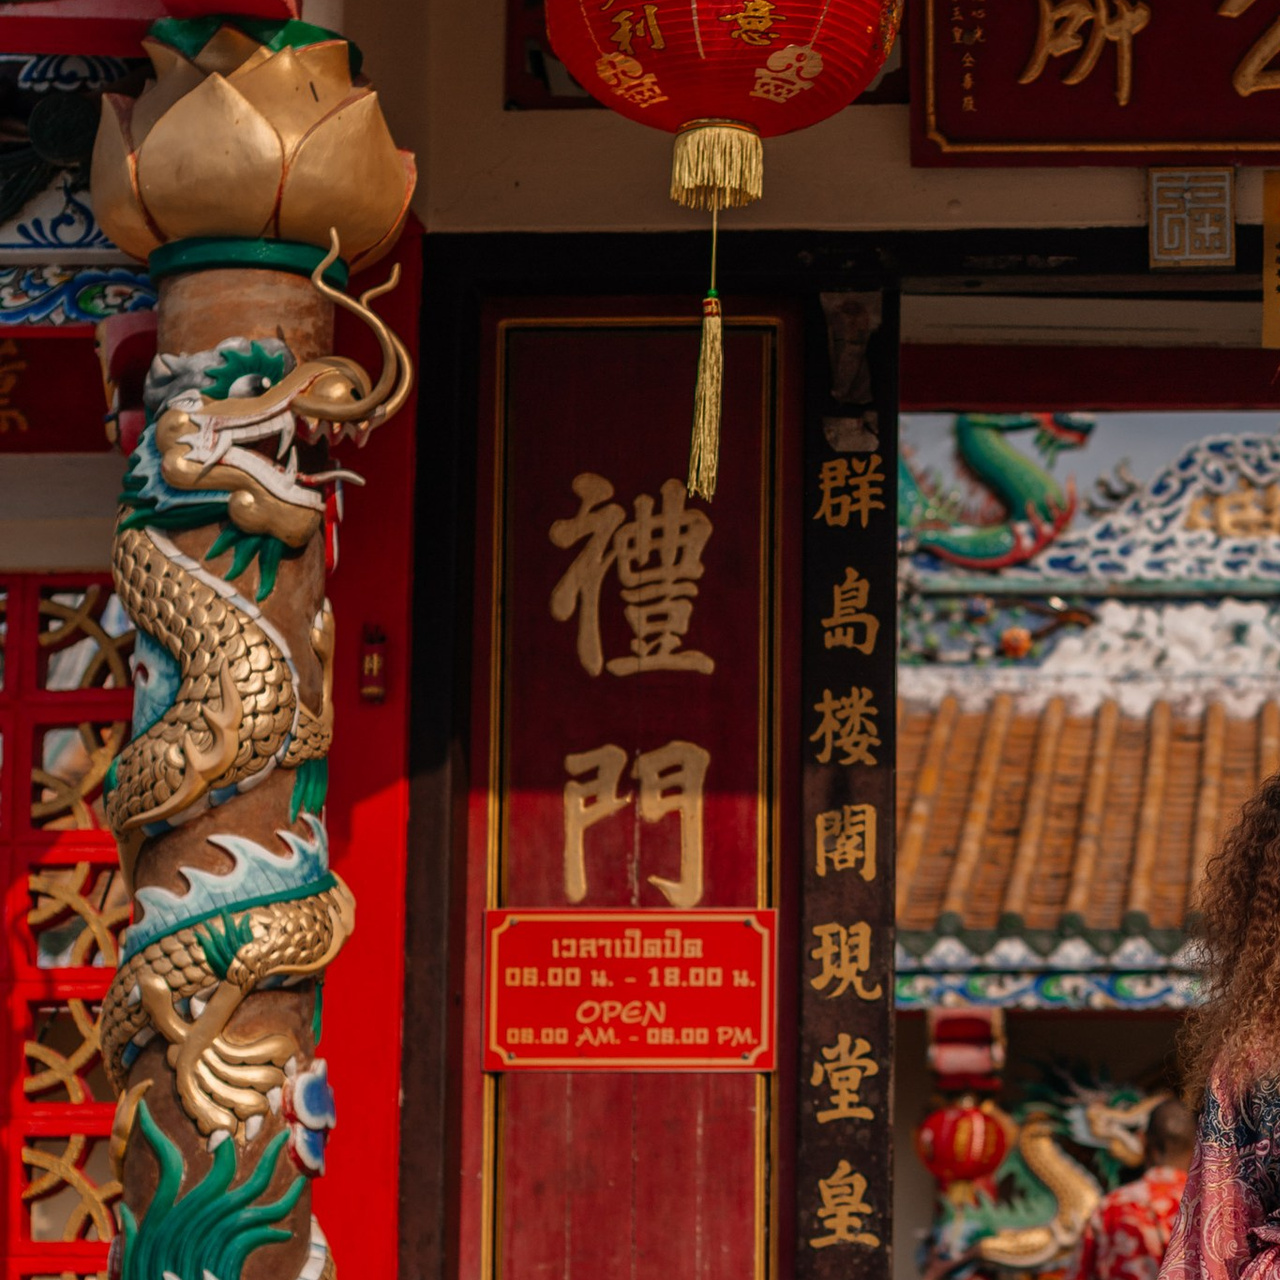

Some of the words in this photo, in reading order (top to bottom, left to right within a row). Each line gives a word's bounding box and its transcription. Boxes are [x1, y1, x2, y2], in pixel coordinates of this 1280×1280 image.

[549, 472, 715, 909] 禮門
[552, 928, 703, 959] เวลาเปิดปิด
[591, 969, 614, 987] น.
[648, 966, 723, 987] 18.00
[733, 969, 757, 987] น.
[575, 1000, 667, 1026] OPEN
[575, 1026, 621, 1047] AM.
[716, 1026, 759, 1047] PM.
